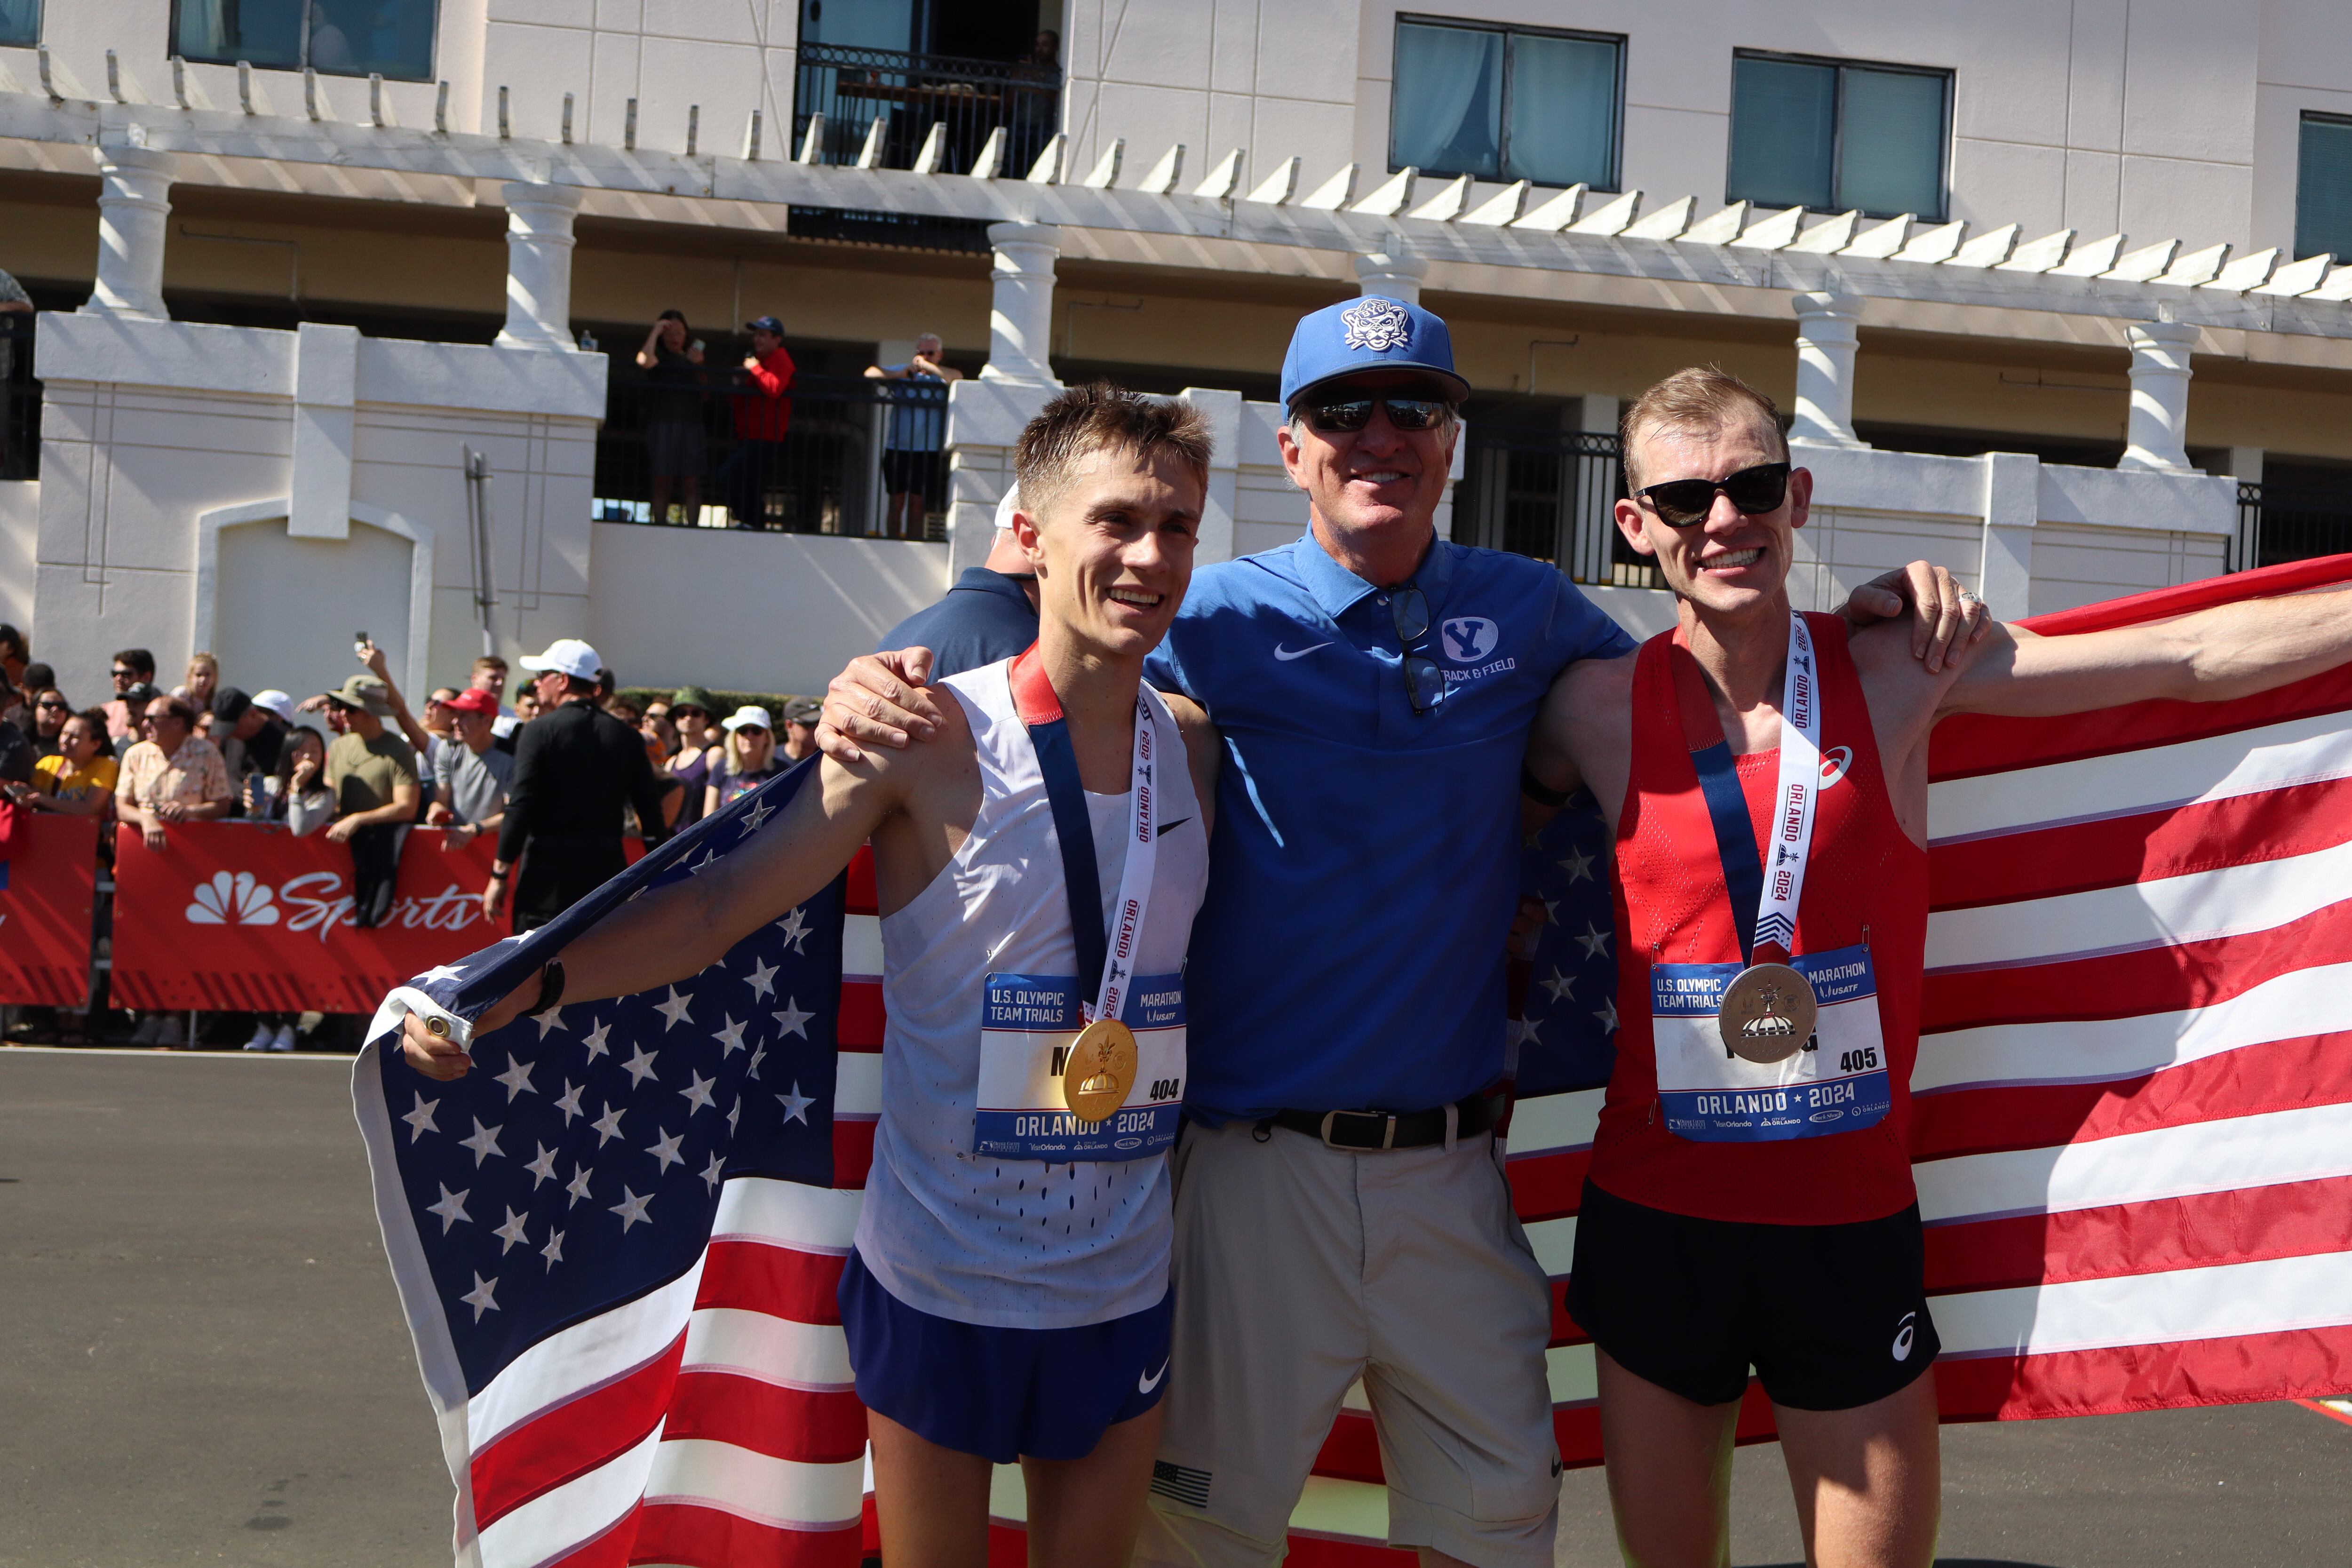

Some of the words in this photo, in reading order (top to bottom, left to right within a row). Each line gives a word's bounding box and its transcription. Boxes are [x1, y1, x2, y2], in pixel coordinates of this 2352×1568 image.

[1361, 306, 1385, 318] BYU
[1444, 621, 1484, 657] Y
[1796, 624, 1807, 652] 2024
[1472, 669, 1481, 678] &
[1482, 657, 1515, 676] FIELD
[1795, 674, 1808, 729] ORLANDO
[1139, 786, 1149, 843] ORLANDO
[1784, 783, 1804, 842] ORLANDO
[1774, 870, 1791, 901] 2024
[1117, 899, 1138, 958] ORLANDO
[1808, 961, 1866, 984] MARATHON
[1657, 979, 1676, 992] U.S.
[1677, 979, 1722, 992] OLYMPIC
[1832, 984, 1859, 995] USATF
[992, 989, 1014, 1003] U.S.
[1016, 990, 1065, 1006] OLYMPIC
[1104, 987, 1119, 1019] 2024
[1140, 990, 1181, 1007] MARATHON
[1657, 995, 1685, 1008] TEAM
[991, 1006, 1022, 1021] TEAM
[1025, 1008, 1064, 1022] TRIALS
[1156, 1012, 1176, 1021] USATF
[1840, 1047, 1878, 1073] 405
[1149, 1078, 1180, 1101] 404
[1697, 1092, 1787, 1114] ORLANDO
[1809, 1082, 1855, 1108] 2024
[1862, 1104, 1890, 1113] ORLANDO
[1016, 1115, 1100, 1136] ORLANDO
[1117, 1111, 1155, 1133] 2024
